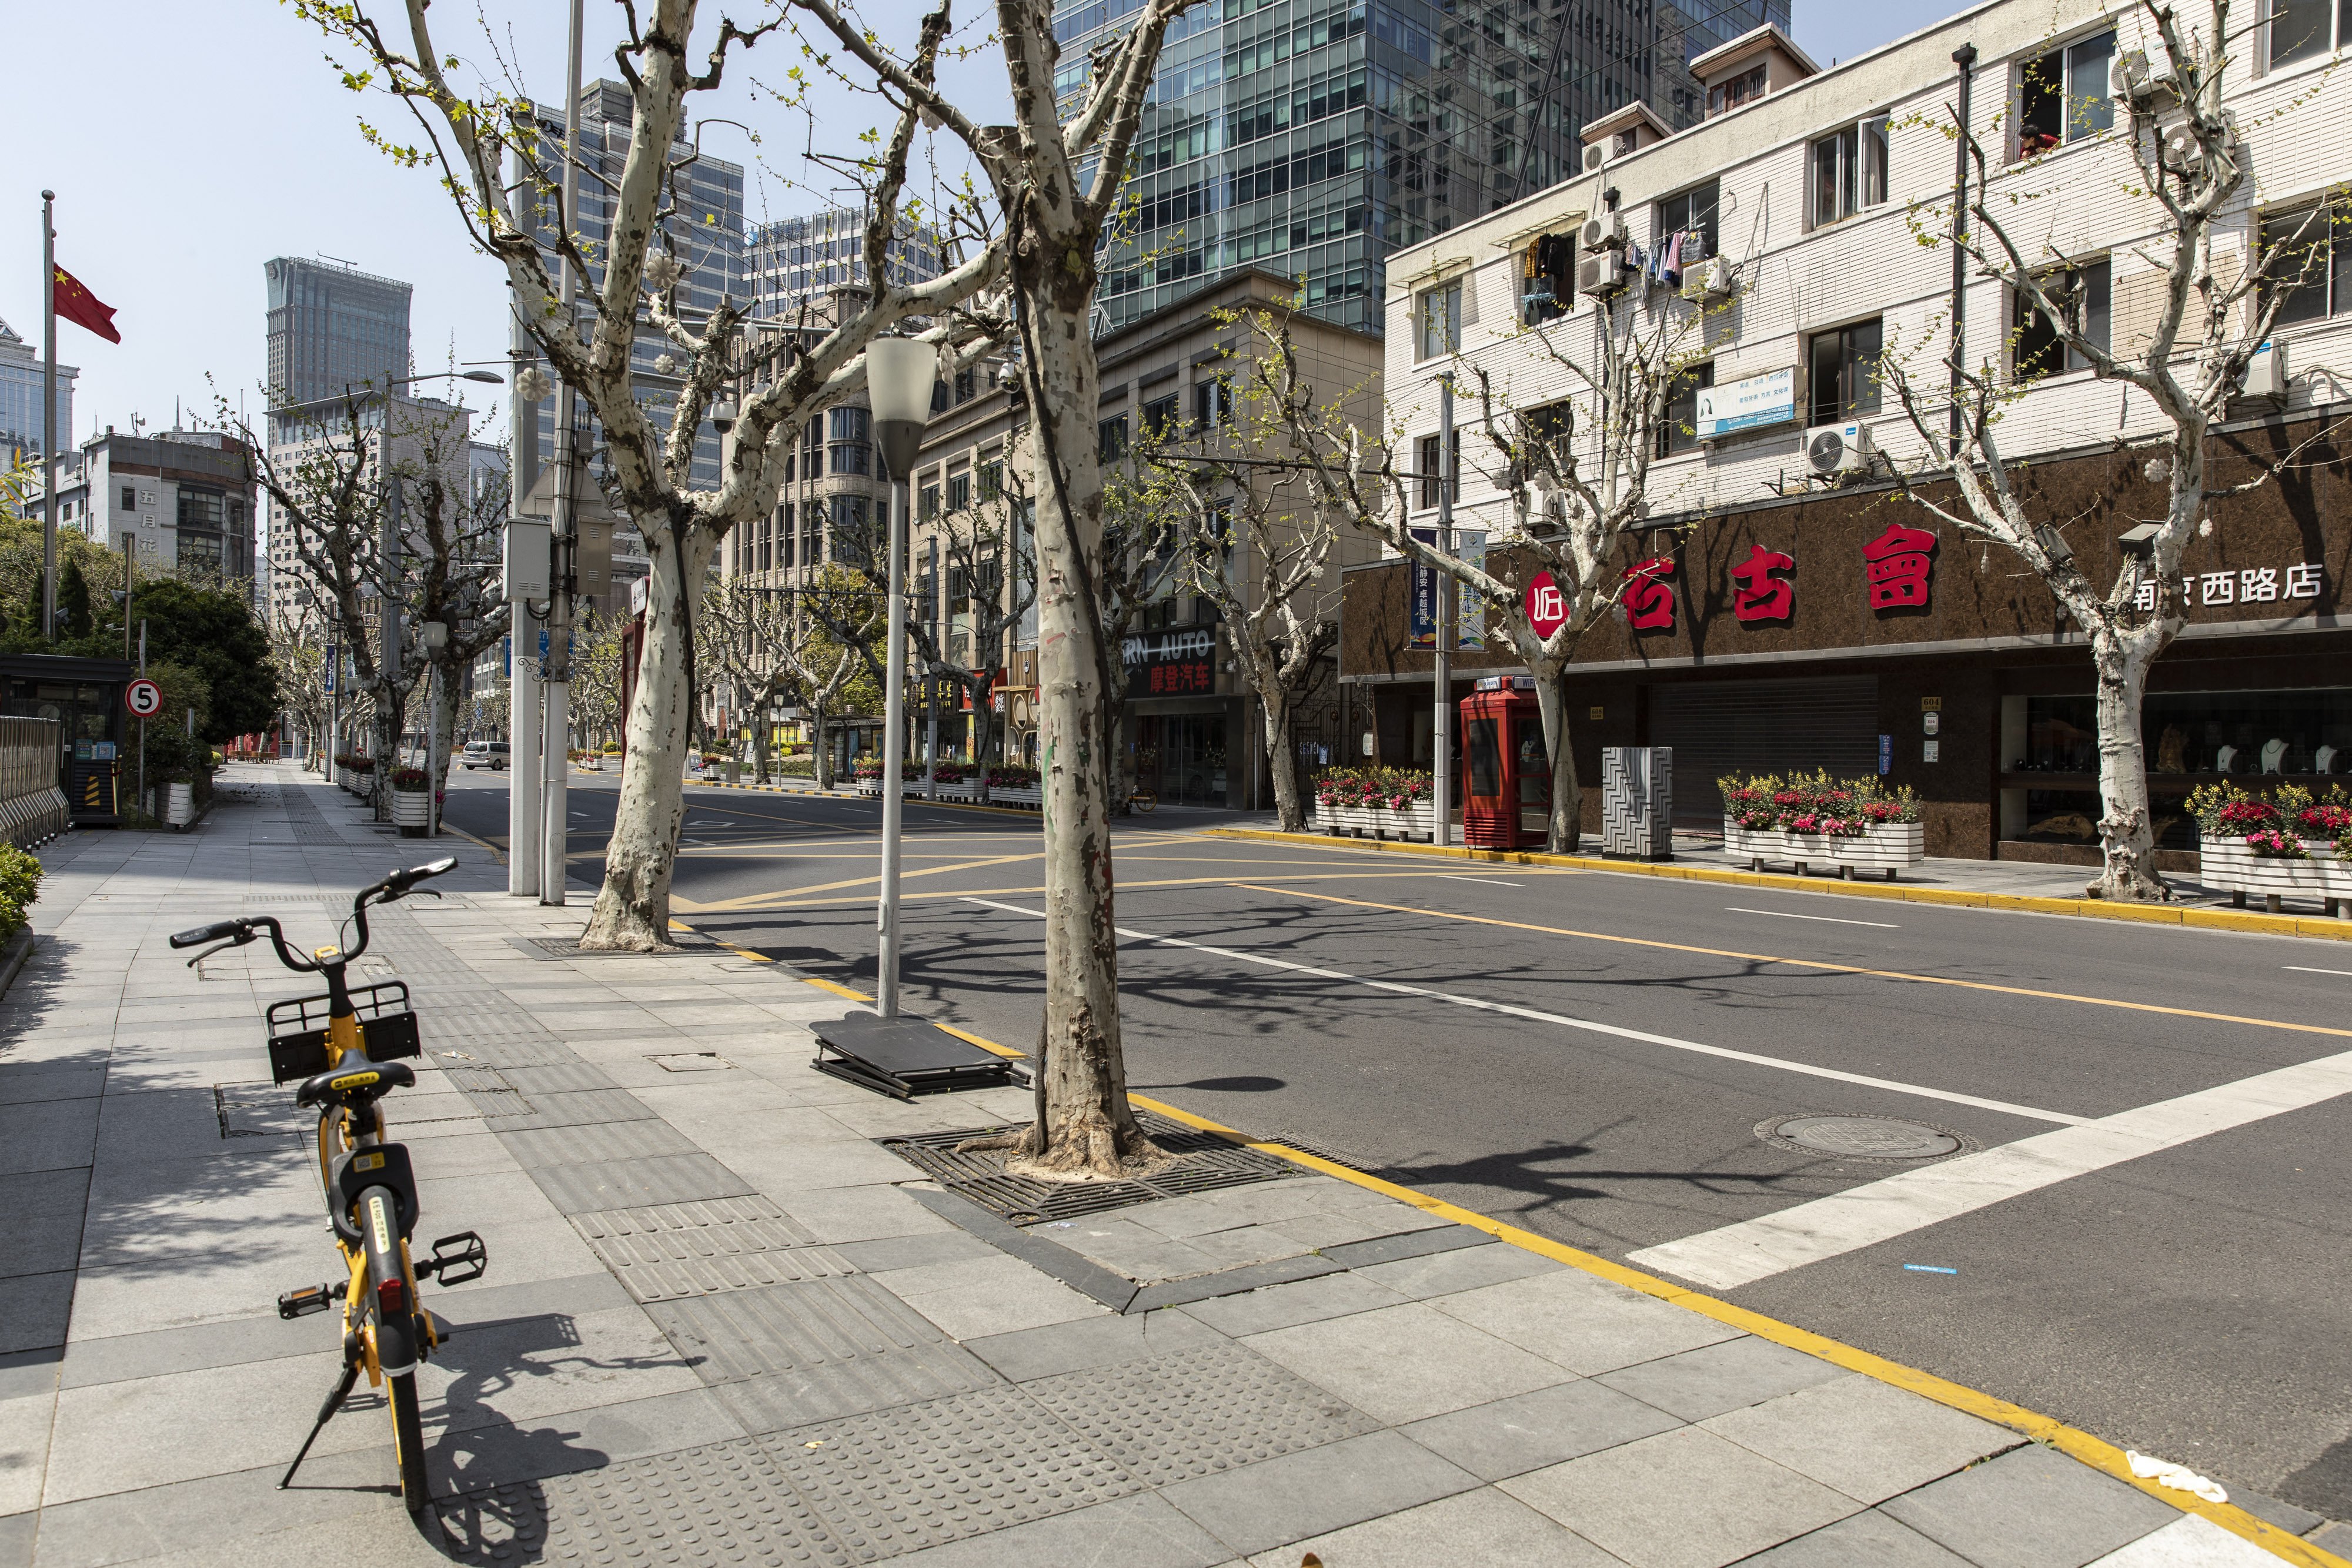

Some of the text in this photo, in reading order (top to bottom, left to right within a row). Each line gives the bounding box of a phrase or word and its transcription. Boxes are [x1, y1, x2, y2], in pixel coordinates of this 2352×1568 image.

[1160, 630, 1209, 661] AUTO
[1150, 661, 1209, 693] 摩登汽车
[137, 687, 153, 710] 5
